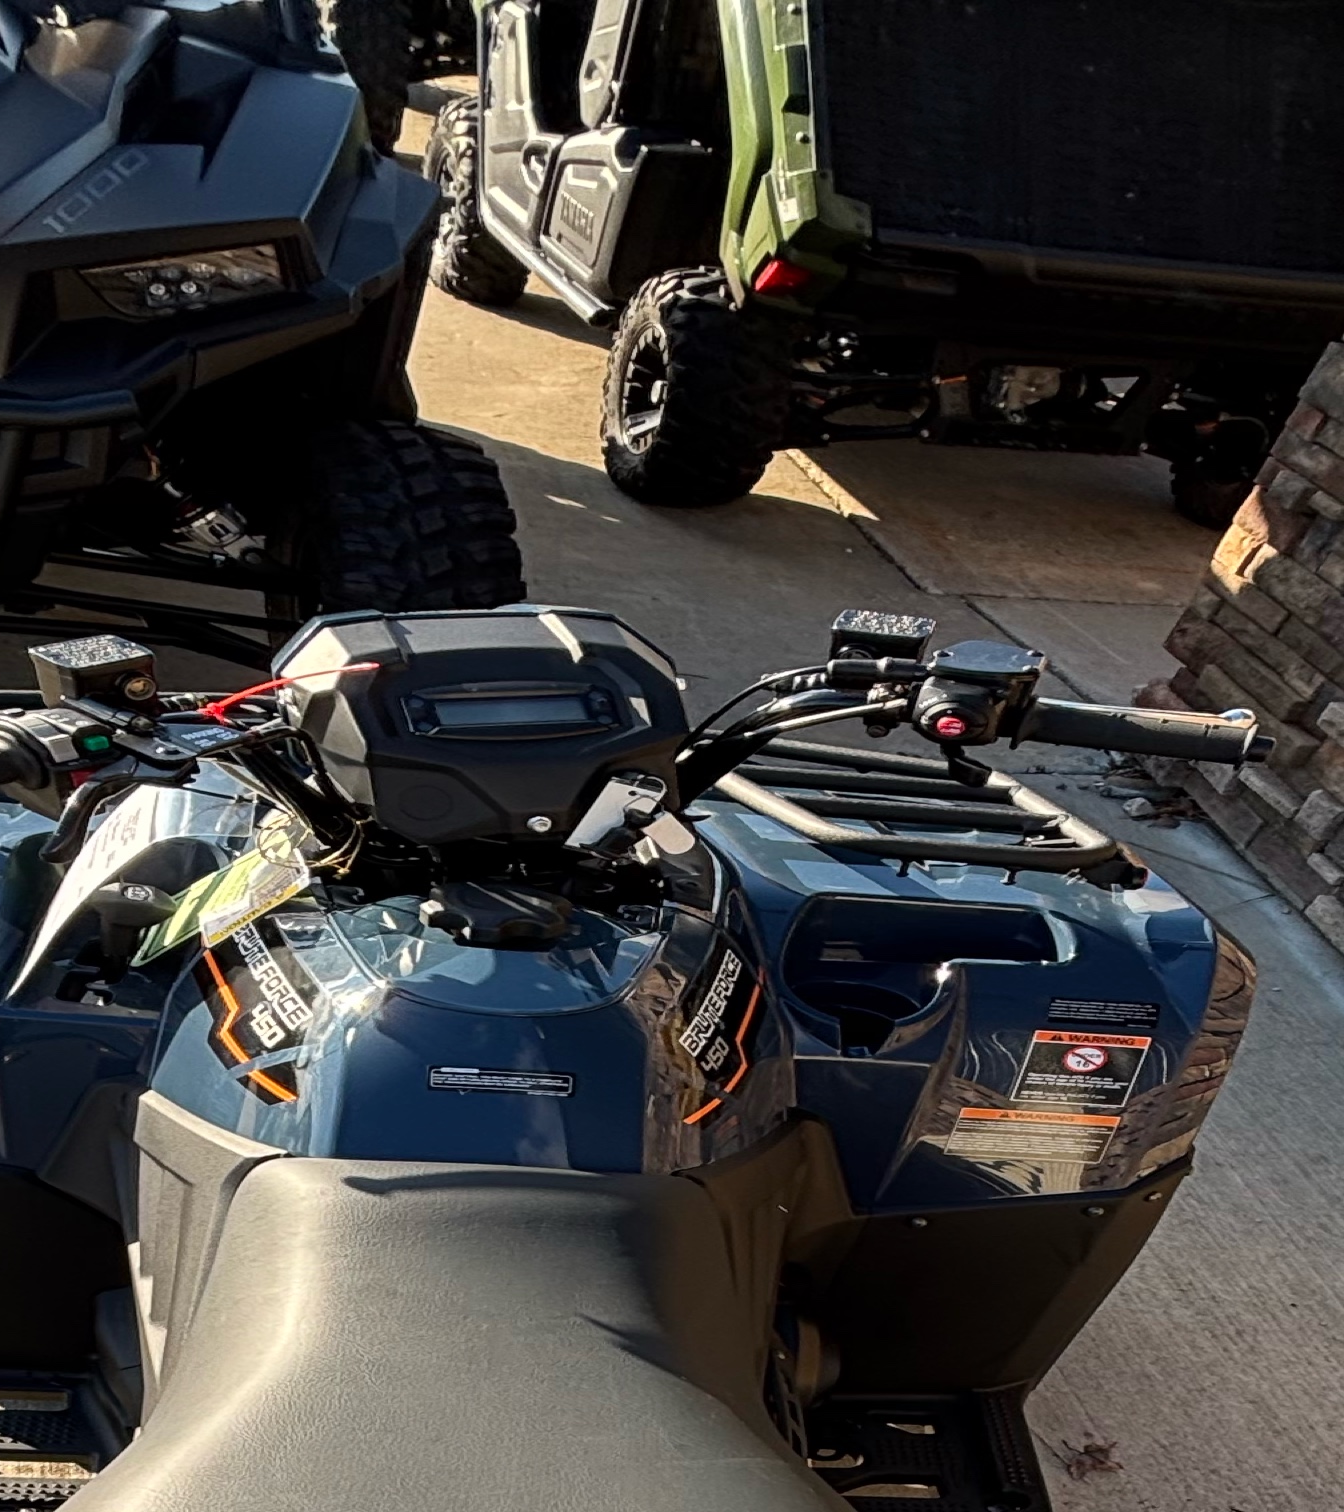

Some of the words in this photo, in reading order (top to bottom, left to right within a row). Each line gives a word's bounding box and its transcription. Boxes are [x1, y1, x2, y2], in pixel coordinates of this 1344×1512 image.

[42, 148, 149, 234] 1000
[251, 1001, 286, 1049] 450
[1068, 1033, 1135, 1046] WARNING
[700, 1035, 730, 1071] 450
[1015, 1111, 1074, 1122] WARNING
